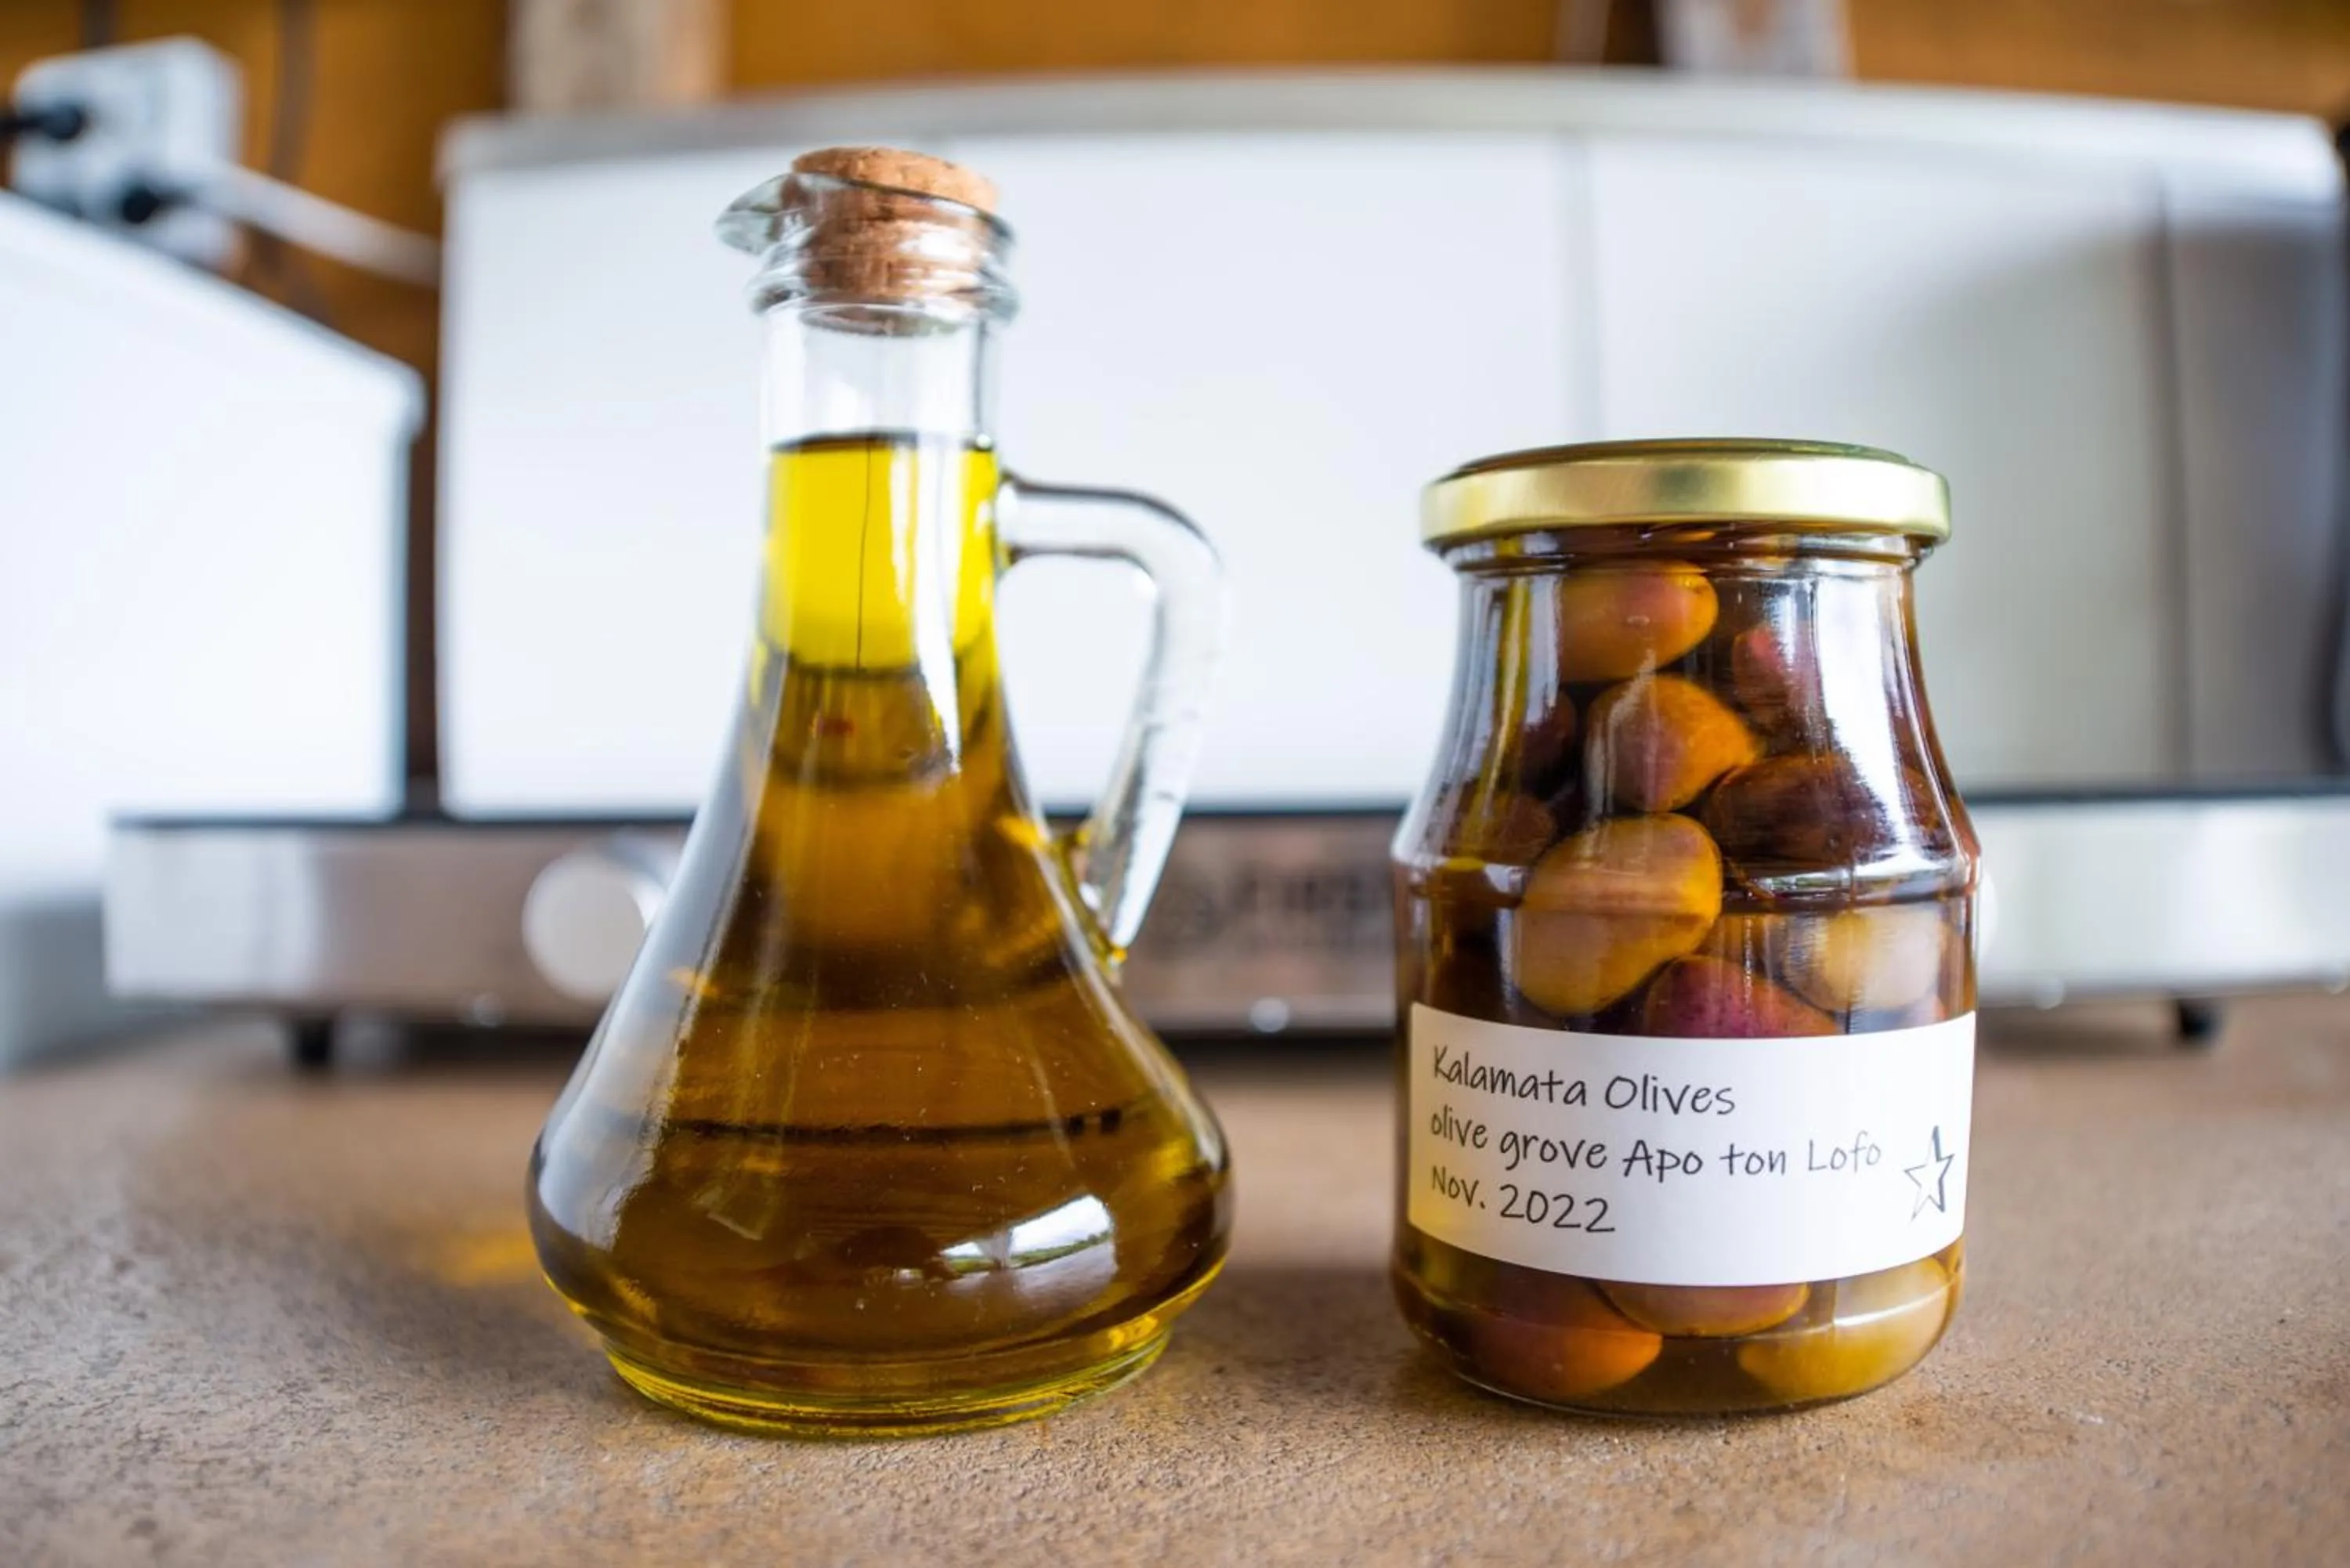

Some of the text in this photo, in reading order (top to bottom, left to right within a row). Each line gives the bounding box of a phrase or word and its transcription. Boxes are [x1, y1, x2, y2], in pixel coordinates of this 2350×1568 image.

[1433, 1044, 1737, 1116] Kalamata Olives
[1431, 1105, 1882, 1183] olive grove Apo ton Lofo
[1431, 1165, 1616, 1234] Nov. 2022
